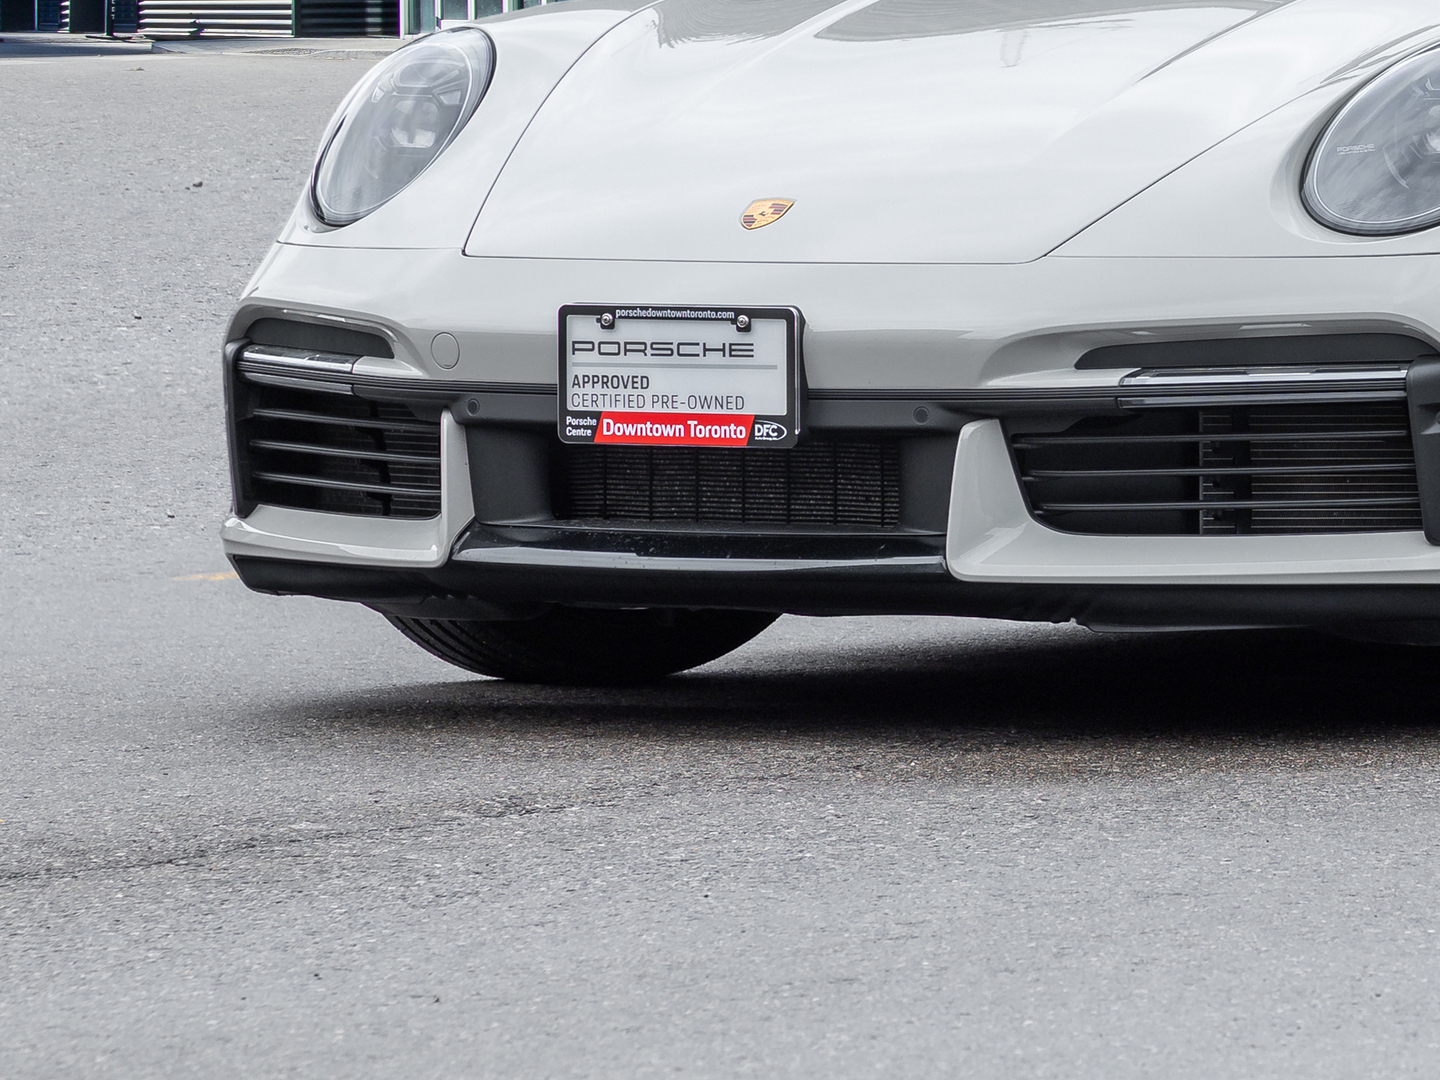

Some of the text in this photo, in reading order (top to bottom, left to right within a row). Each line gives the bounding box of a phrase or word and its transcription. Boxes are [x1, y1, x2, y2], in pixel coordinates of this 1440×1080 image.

[615, 308, 735, 319] porschedowntowntoronto.com
[571, 340, 754, 358] PORSCHE
[572, 374, 650, 390] APPROVED
[571, 393, 745, 410] CERTIFIED PRE-OWNED
[566, 416, 597, 426] Porsche
[566, 426, 592, 437] Centre
[602, 418, 746, 439] Downtown Toronto
[754, 424, 778, 437] DFC
